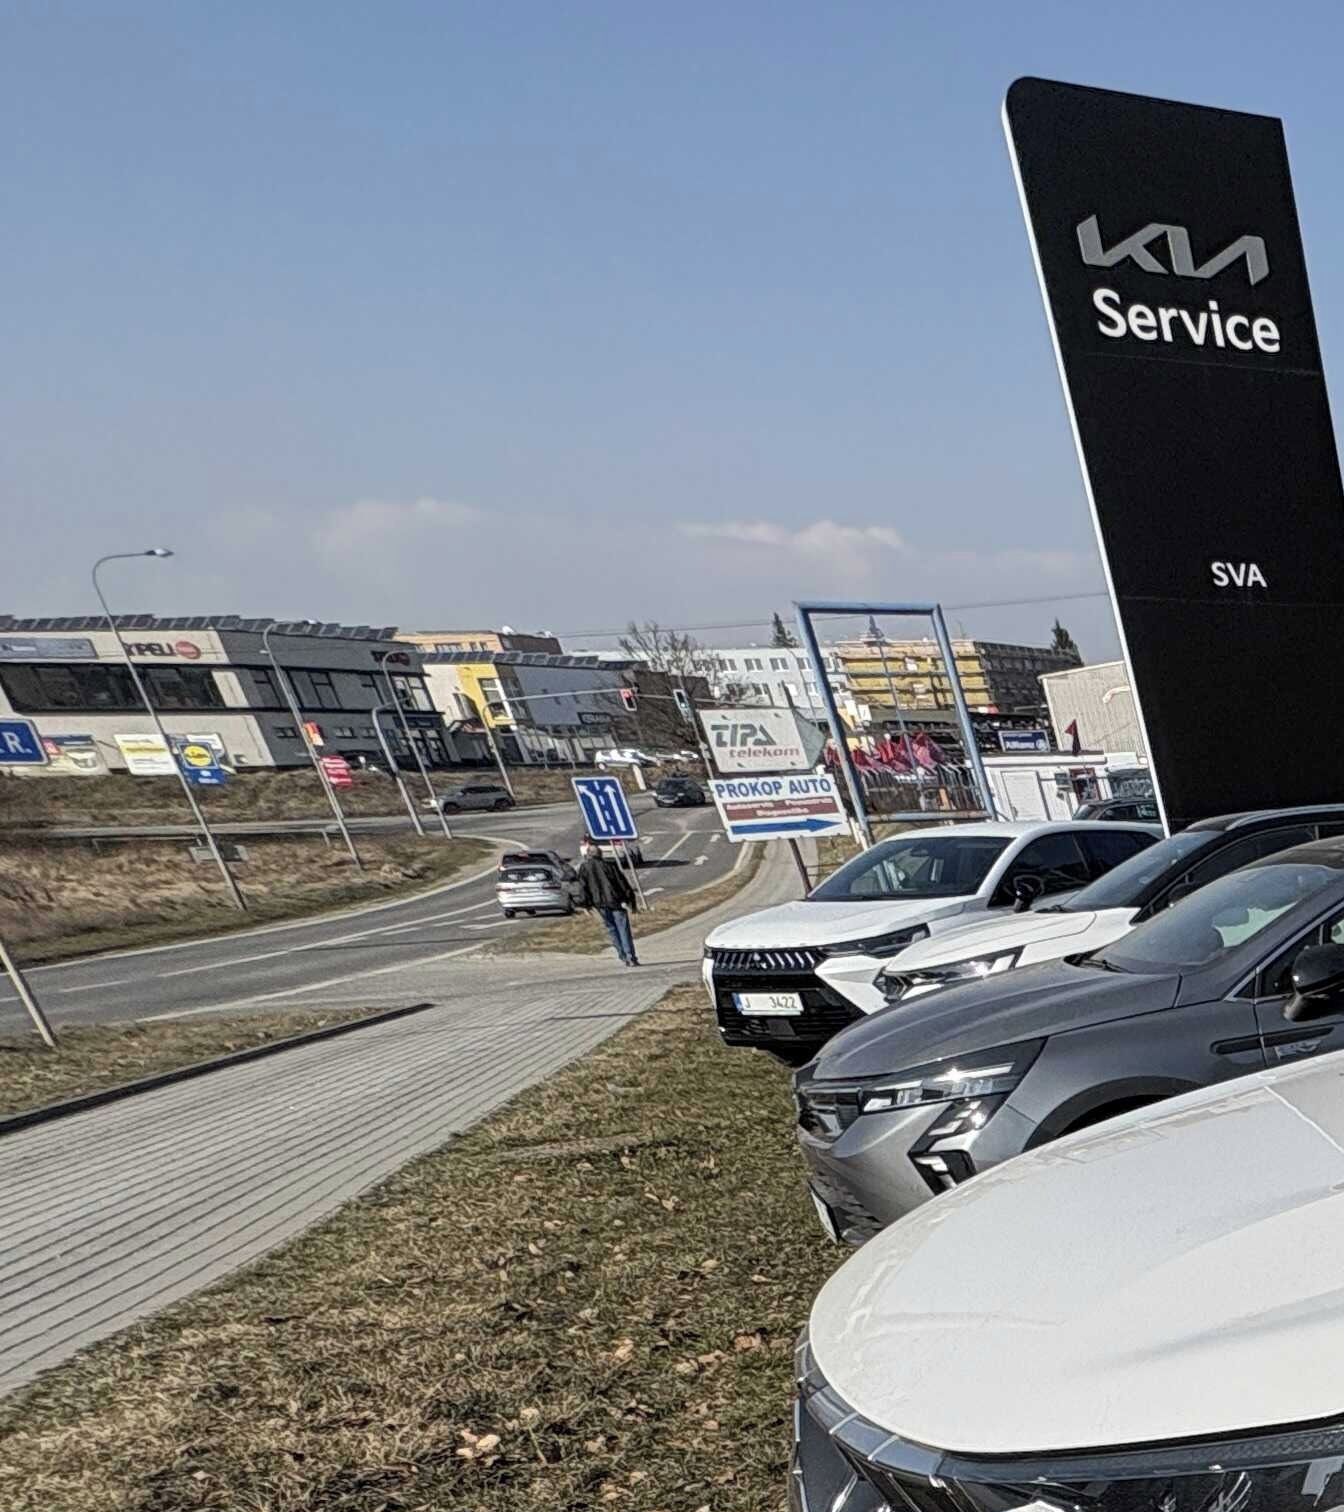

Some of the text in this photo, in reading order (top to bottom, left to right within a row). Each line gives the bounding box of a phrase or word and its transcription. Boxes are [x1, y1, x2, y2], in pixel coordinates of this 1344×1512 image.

[1076, 214, 1270, 286] KIA
[1092, 288, 1281, 353] Service
[1211, 561, 1266, 588] SVA
[711, 724, 777, 747] TIPA
[729, 744, 800, 758] telekom
[715, 778, 832, 798] PROKOP AUTO
